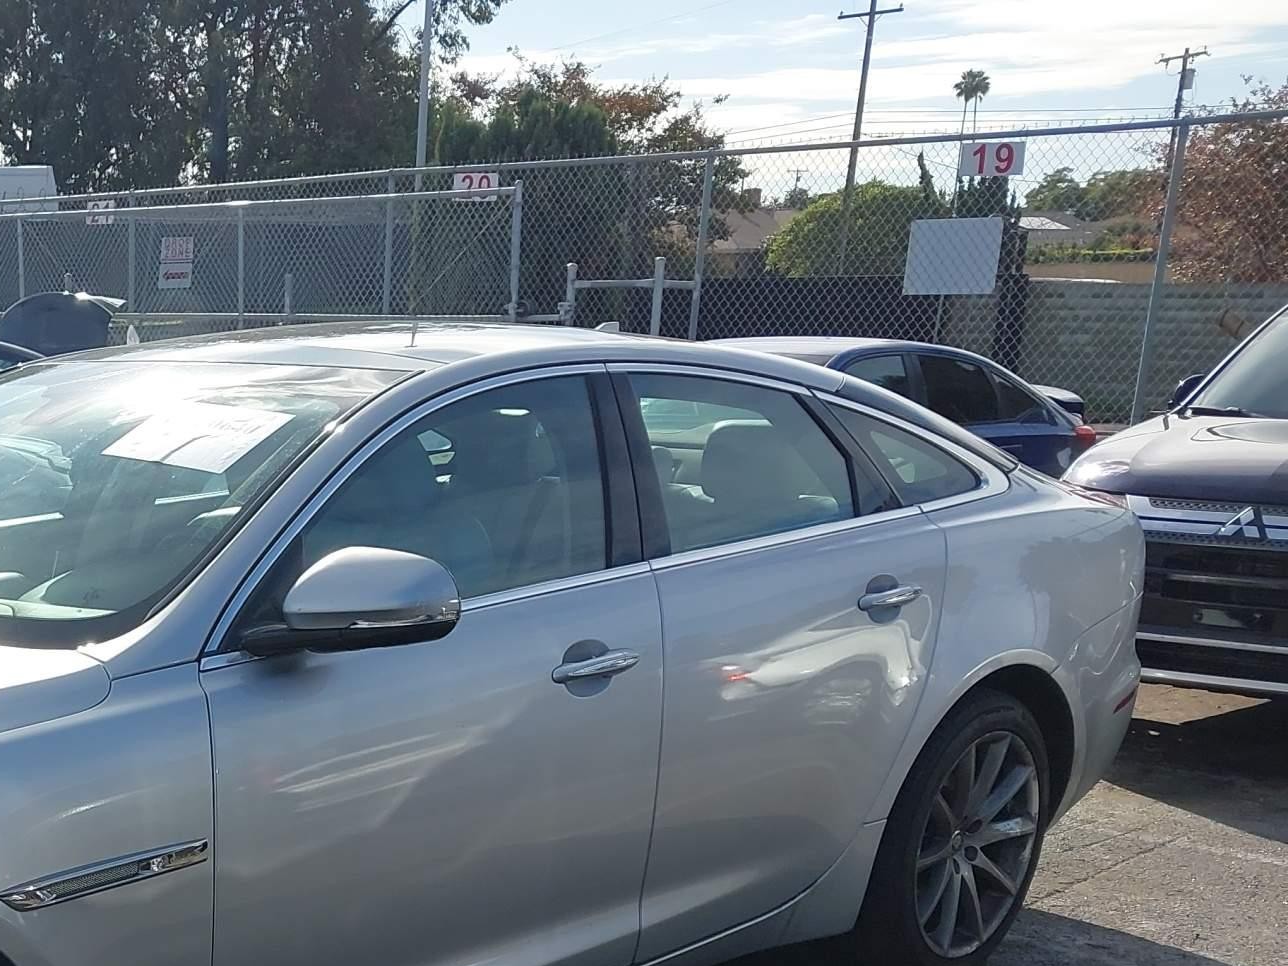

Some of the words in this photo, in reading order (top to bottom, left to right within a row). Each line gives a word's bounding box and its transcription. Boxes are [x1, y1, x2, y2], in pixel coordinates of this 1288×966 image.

[972, 142, 1014, 174] 19
[461, 174, 491, 200] 20
[164, 247, 191, 258] ZONE
